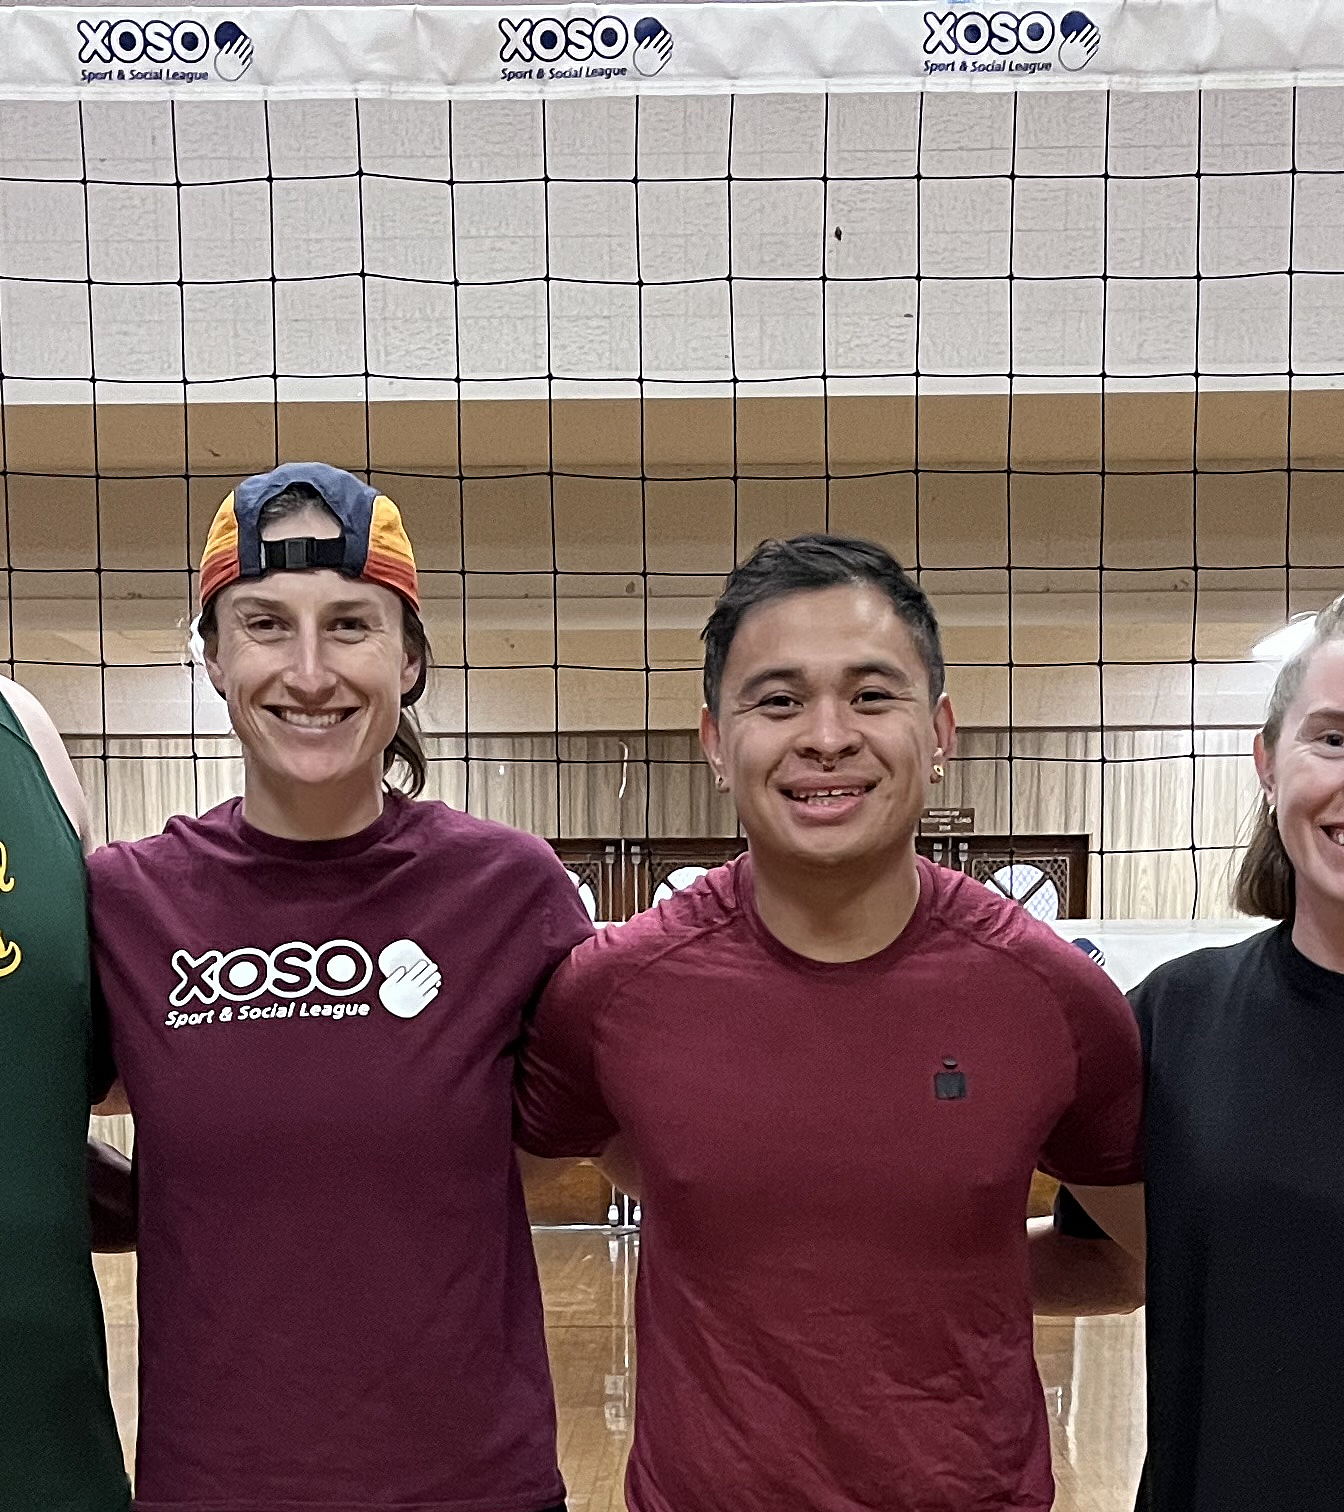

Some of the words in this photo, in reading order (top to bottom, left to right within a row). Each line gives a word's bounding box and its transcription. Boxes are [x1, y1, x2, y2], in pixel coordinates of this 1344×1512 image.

[77, 20, 209, 63] XOSO
[499, 16, 628, 62] XOSO
[923, 11, 1054, 55] XOSO
[81, 70, 113, 82] Sport
[129, 69, 162, 80] Social
[166, 69, 208, 81] League
[501, 67, 533, 80] Sport
[549, 67, 583, 78] Social
[585, 66, 627, 78] League
[924, 61, 955, 73] Sport
[970, 60, 1006, 72] Social
[1008, 61, 1052, 73] League
[168, 939, 373, 1007] XOSO
[165, 1010, 214, 1028] Sport
[219, 1006, 232, 1022] &
[237, 1002, 295, 1021] Social
[300, 1002, 370, 1019] League
